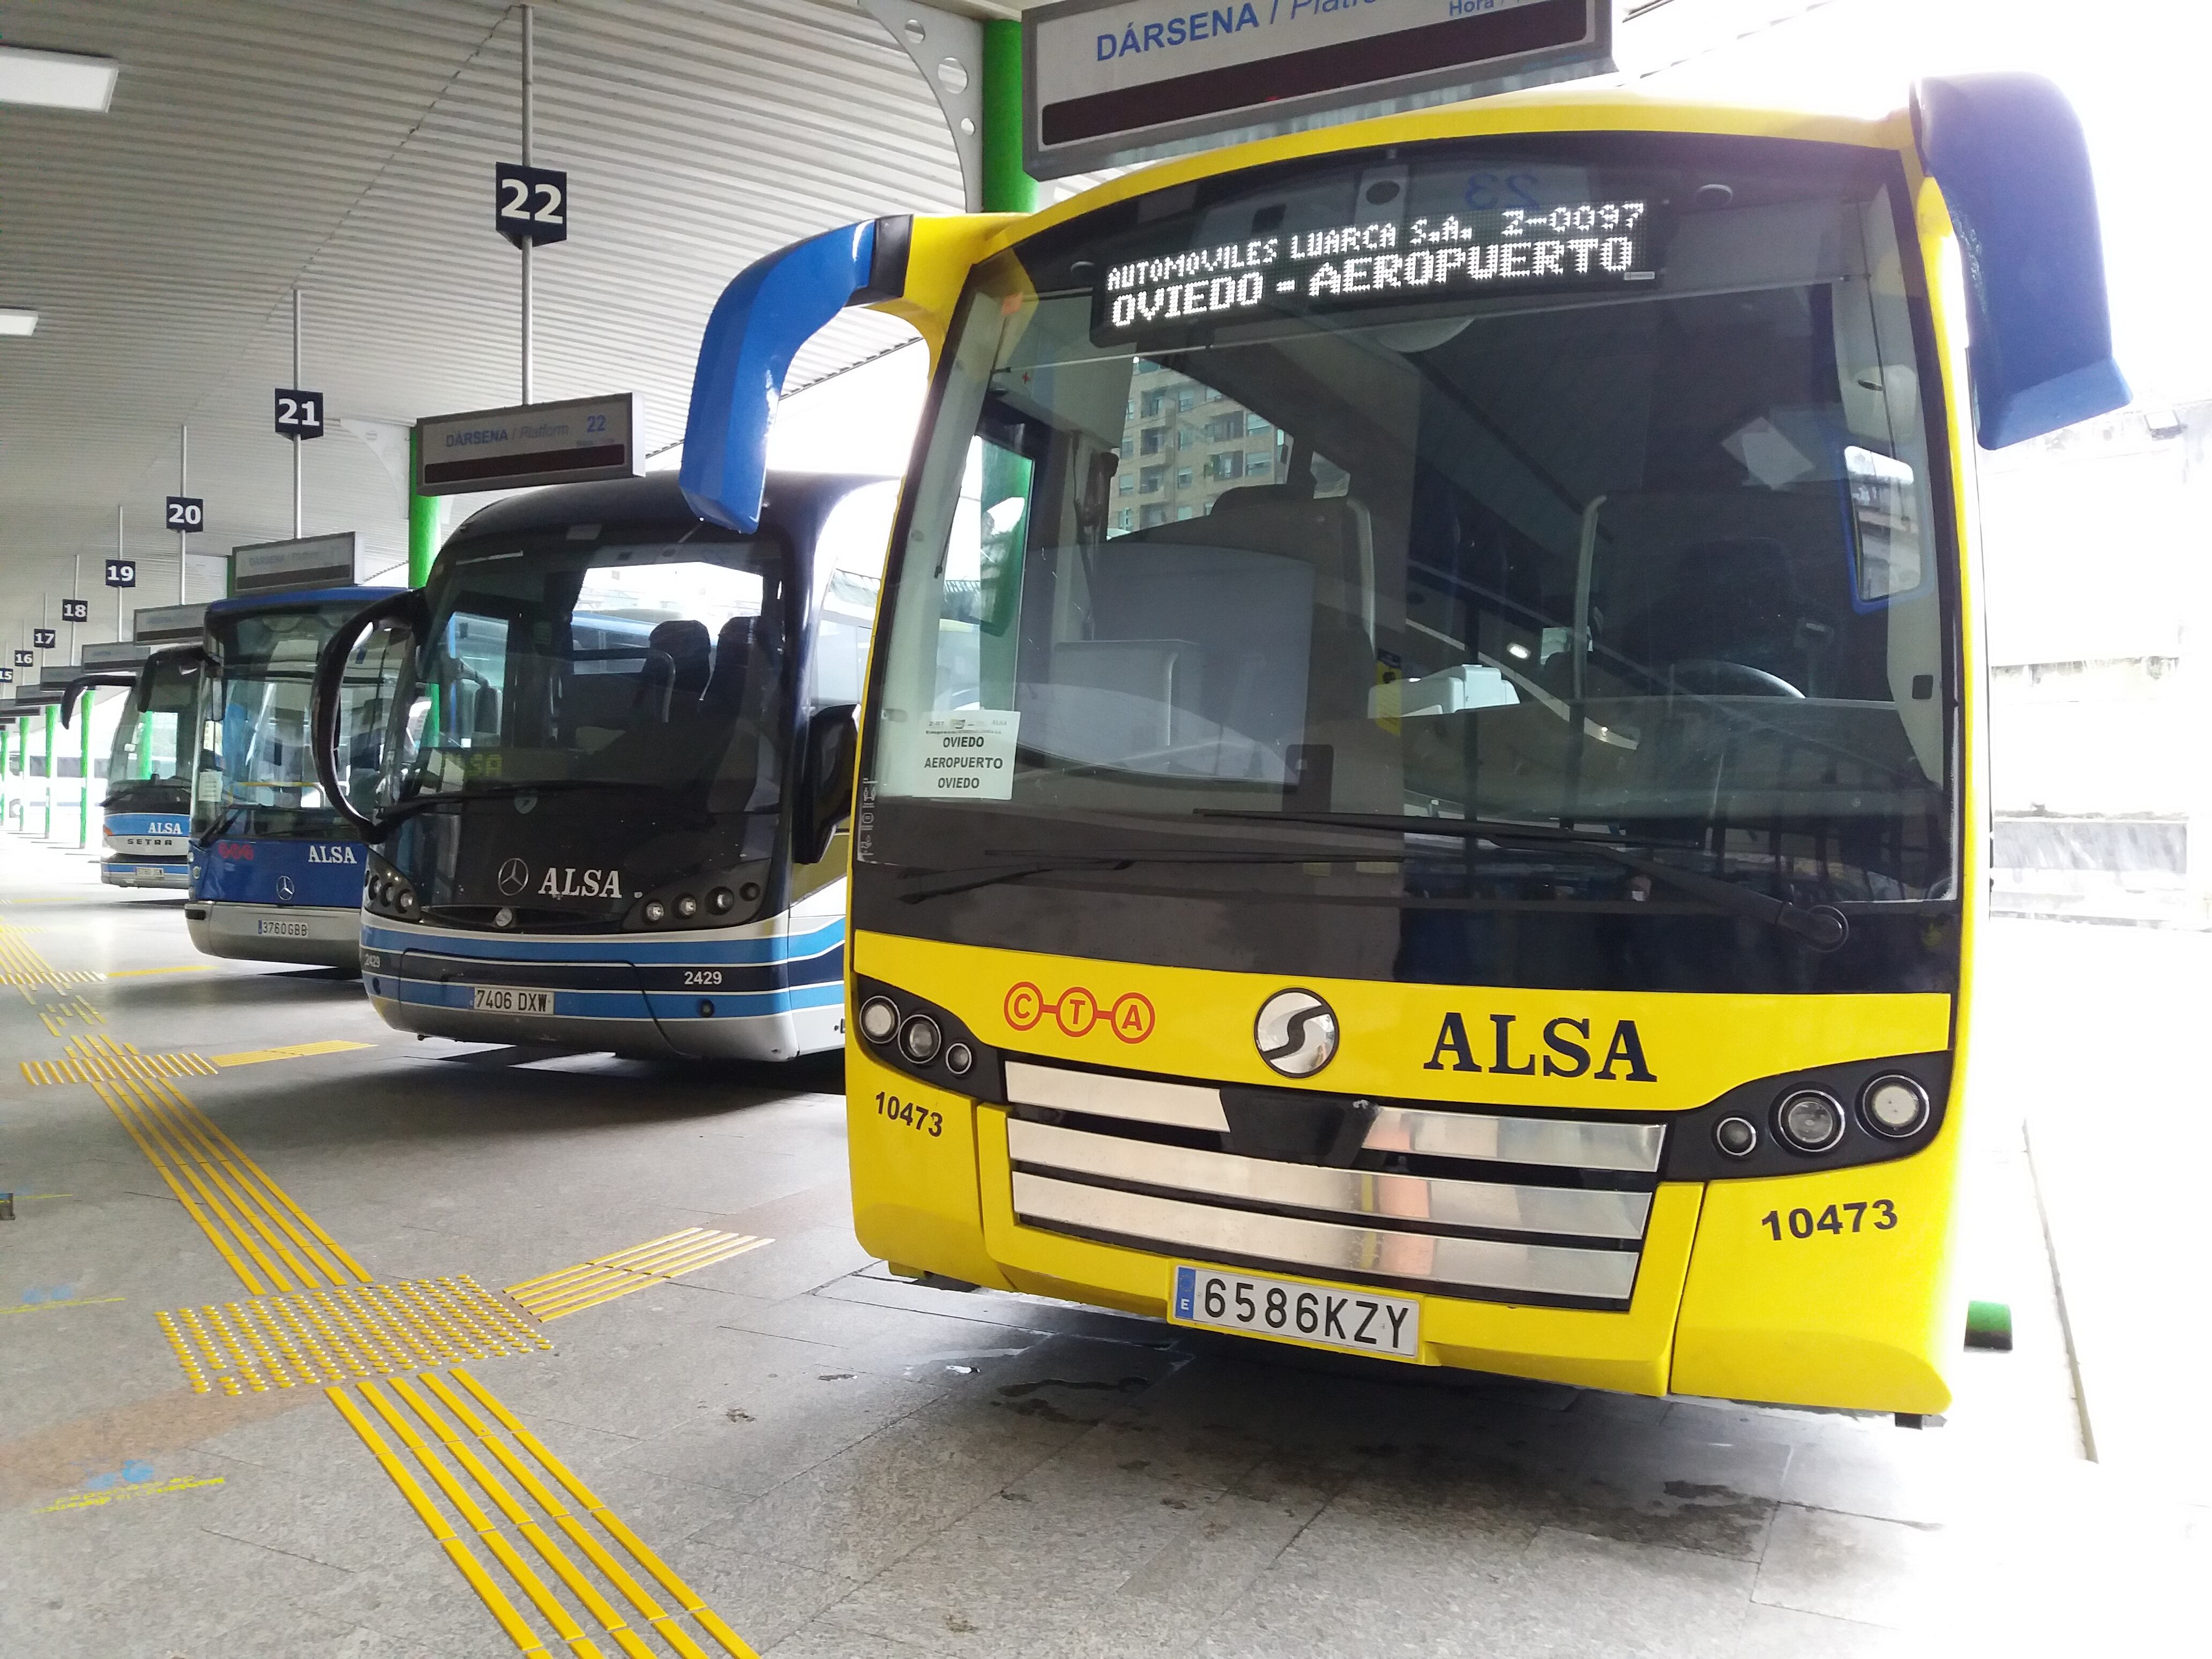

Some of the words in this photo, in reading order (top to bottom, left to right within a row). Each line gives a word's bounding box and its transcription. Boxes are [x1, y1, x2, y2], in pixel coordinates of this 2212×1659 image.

[1097, 2, 1260, 61] DÁRSENA
[501, 178, 563, 224] 22
[1107, 238, 1278, 290] AUTOMOVILES
[1290, 223, 1396, 260] LUARCA
[1410, 215, 1473, 245] S.A.
[1111, 271, 1264, 327] OVIEDO
[1308, 235, 1633, 297] AEROPUERTO
[278, 398, 320, 427] 21
[586, 415, 606, 432] 22
[168, 504, 201, 525] 20
[108, 565, 134, 581] 19
[63, 603, 87, 618] 18
[34, 632, 55, 644] 17
[15, 653, 33, 664] 16
[943, 736, 985, 748] OVIEDO
[924, 757, 1004, 769] AEROPUERTO
[937, 777, 980, 789] OVIEDO
[147, 822, 183, 834] ALSA
[308, 845, 357, 864] ALSA
[537, 862, 622, 899] ALSA
[684, 970, 722, 985] 2429
[477, 990, 512, 1010] 7406
[1423, 1011, 1658, 1083] ALSA
[875, 1091, 943, 1138] 10473
[1761, 1199, 1898, 1241] 10473
